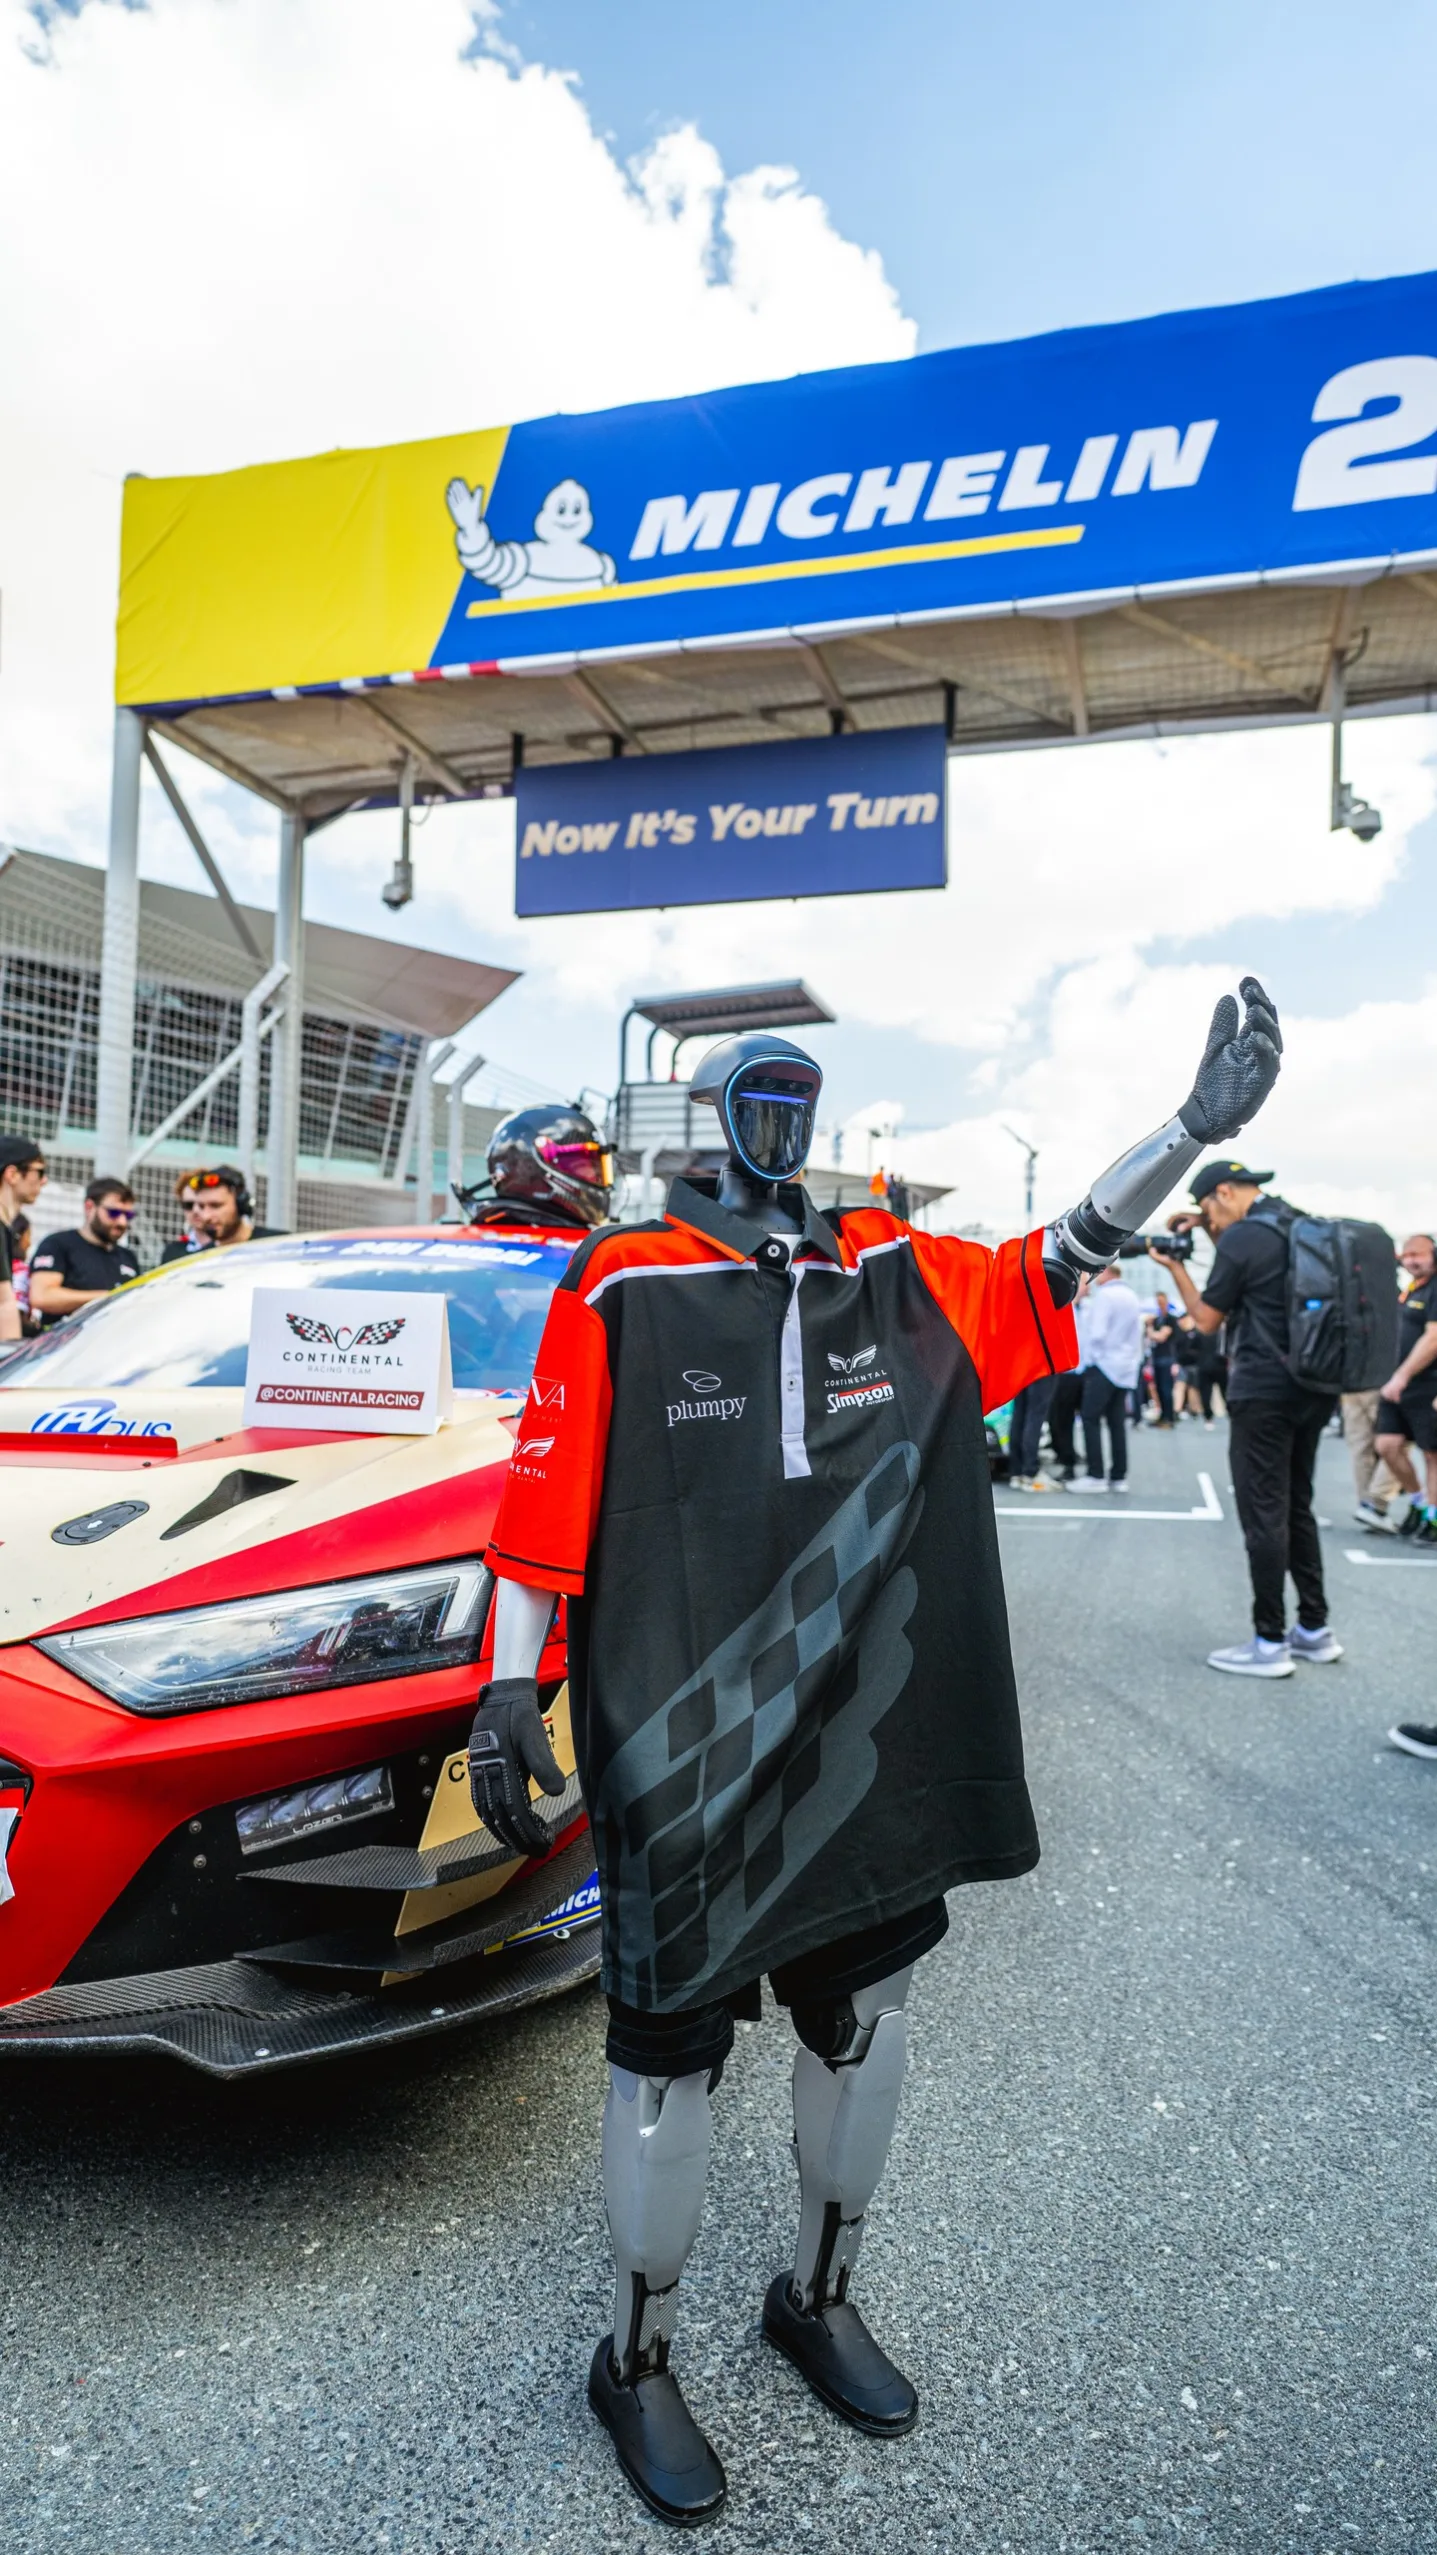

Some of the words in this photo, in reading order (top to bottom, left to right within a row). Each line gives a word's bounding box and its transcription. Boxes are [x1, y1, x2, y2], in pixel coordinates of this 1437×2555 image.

[629, 419, 1219, 561] MICHELIN
[520, 821, 618, 858] Now
[625, 809, 698, 849] It's
[708, 803, 817, 842] Your
[827, 792, 939, 831] Turn
[282, 1351, 403, 1367] CONTINENTAL
[307, 1365, 342, 1374] RACING
[347, 1367, 372, 1375] TEAM
[824, 1369, 887, 1387] CONTINENTAL
[260, 1387, 420, 1407] @CONTINENTAL.RACING
[827, 1384, 894, 1413] Simpson
[666, 1397, 747, 1427] plumpy
